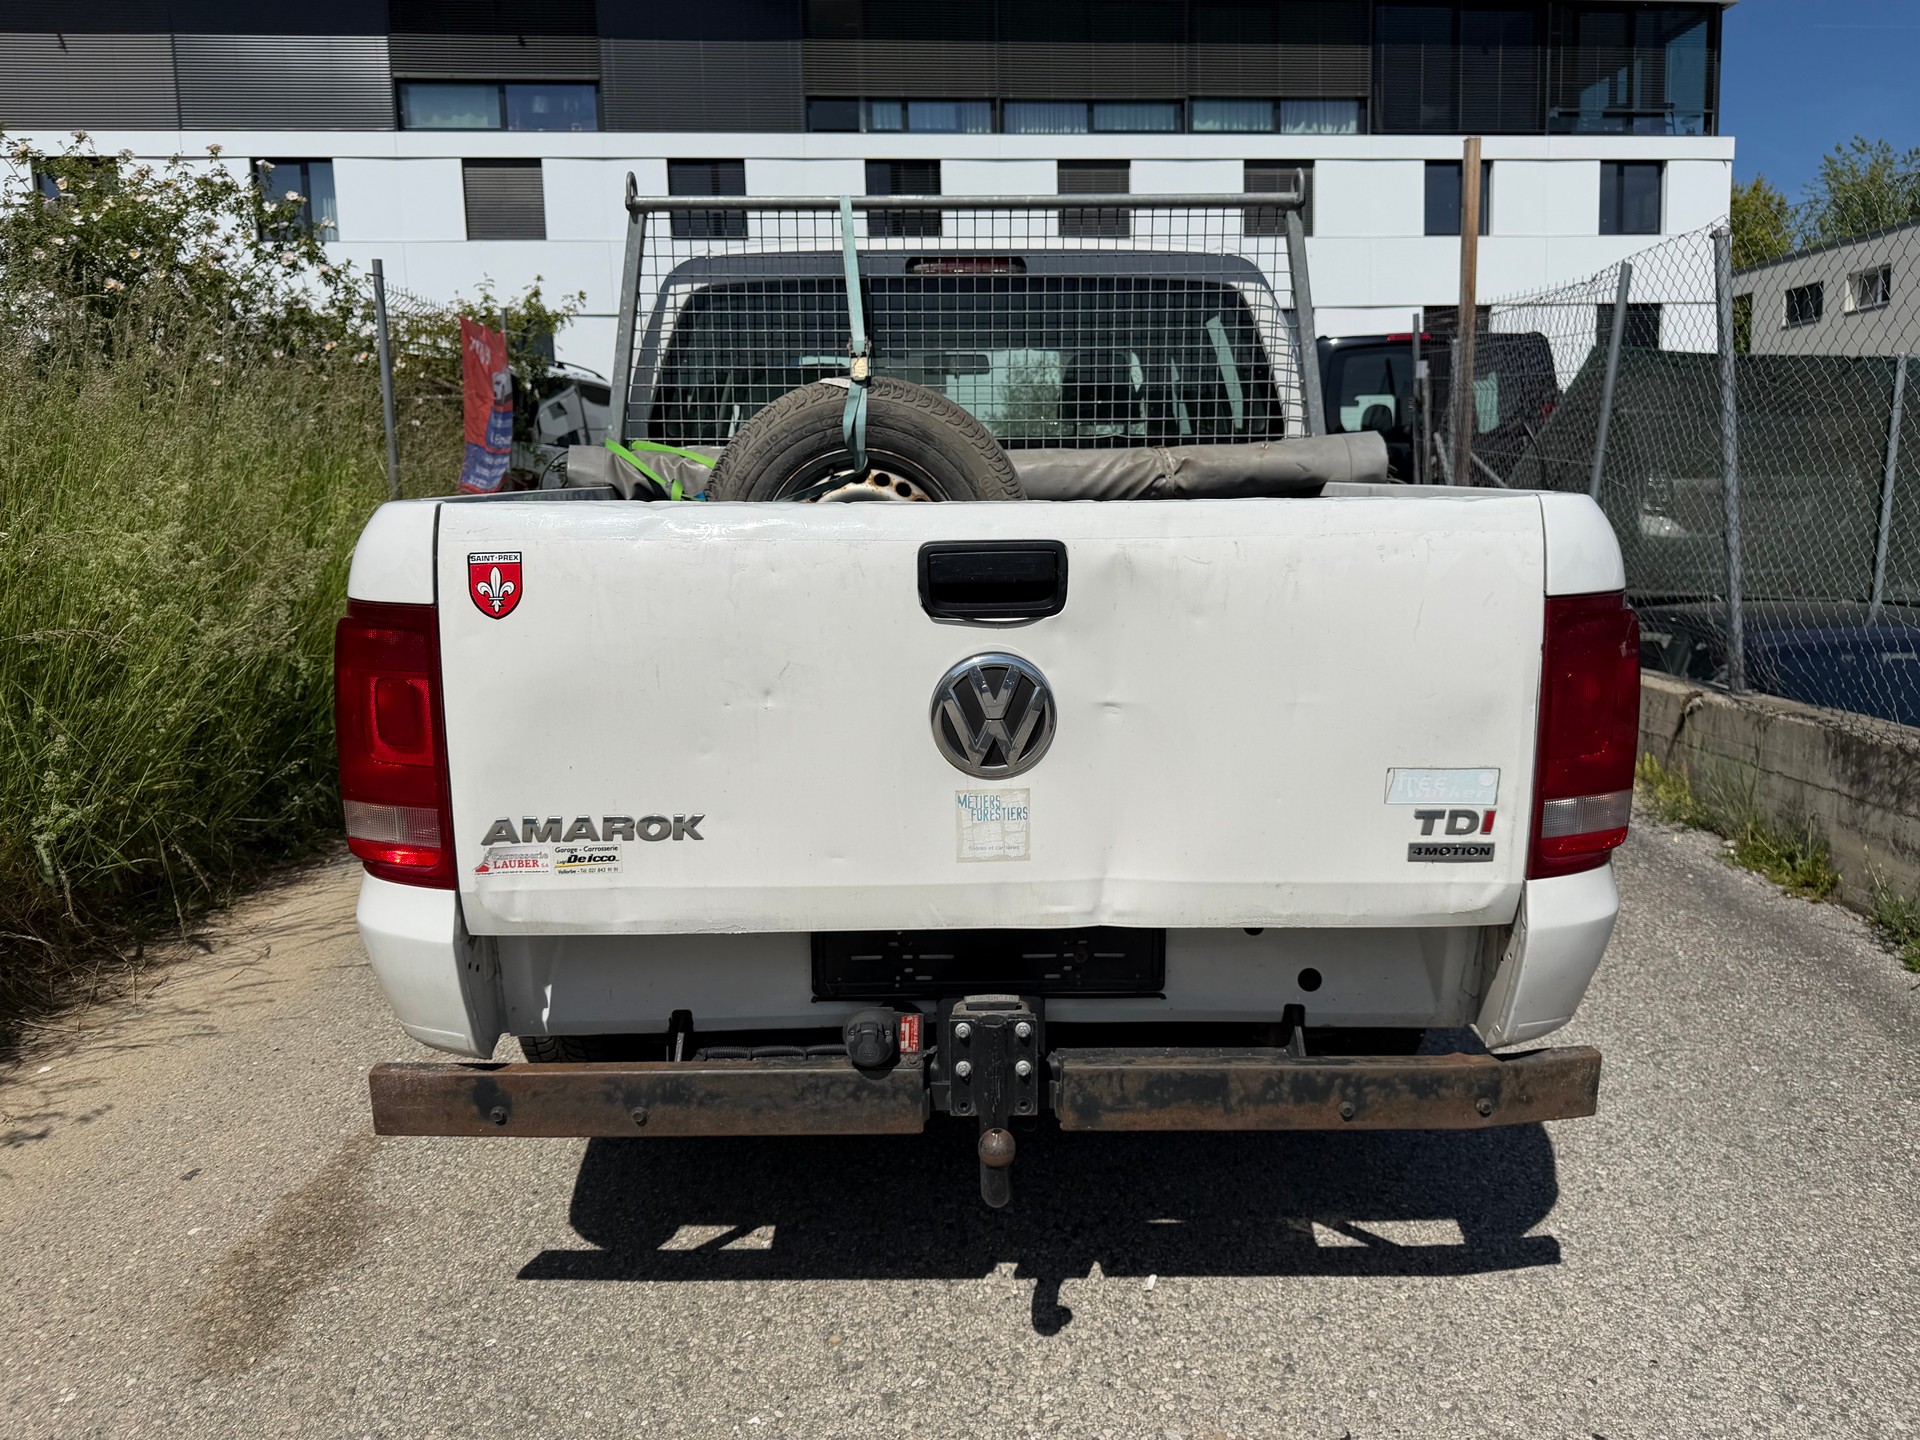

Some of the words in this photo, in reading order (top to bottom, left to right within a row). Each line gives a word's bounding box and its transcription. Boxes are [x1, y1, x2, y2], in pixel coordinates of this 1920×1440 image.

[935, 657, 1053, 775] VW
[971, 806, 1028, 822] FORESTIERS
[1414, 808, 1497, 836] TDI
[480, 813, 706, 846] AMAROK
[555, 846, 578, 854] Garage
[1412, 846, 1491, 857] 4MOTION
[493, 859, 539, 869] LAUBER
